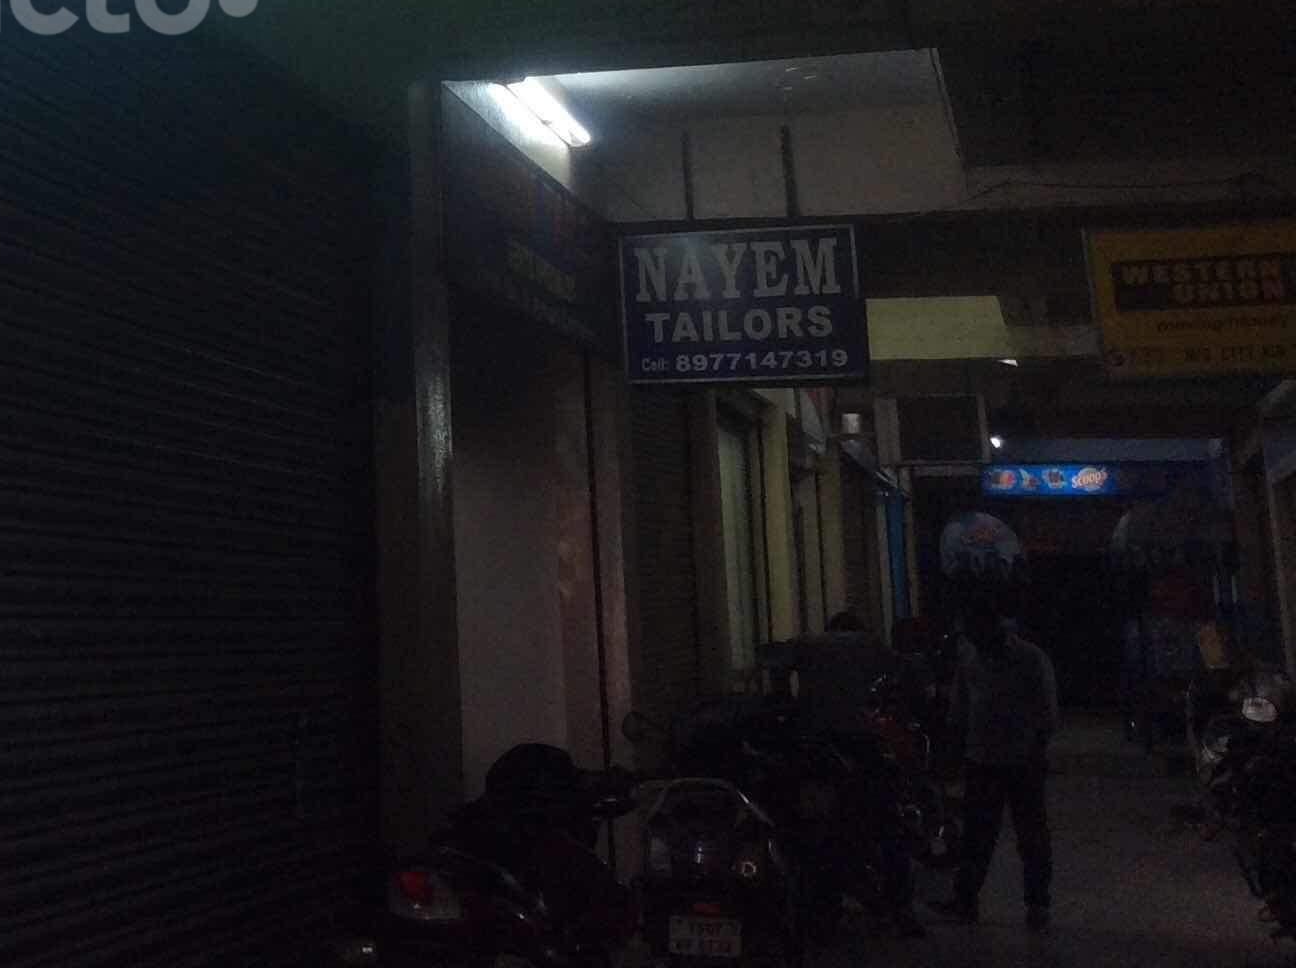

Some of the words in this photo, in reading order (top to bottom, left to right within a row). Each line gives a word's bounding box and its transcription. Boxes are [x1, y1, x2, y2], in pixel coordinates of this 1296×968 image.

[633, 237, 841, 303] NAYEM
[1120, 258, 1281, 283] WESTERN
[644, 305, 834, 344] TAILORS
[675, 349, 848, 373] 8977147319
